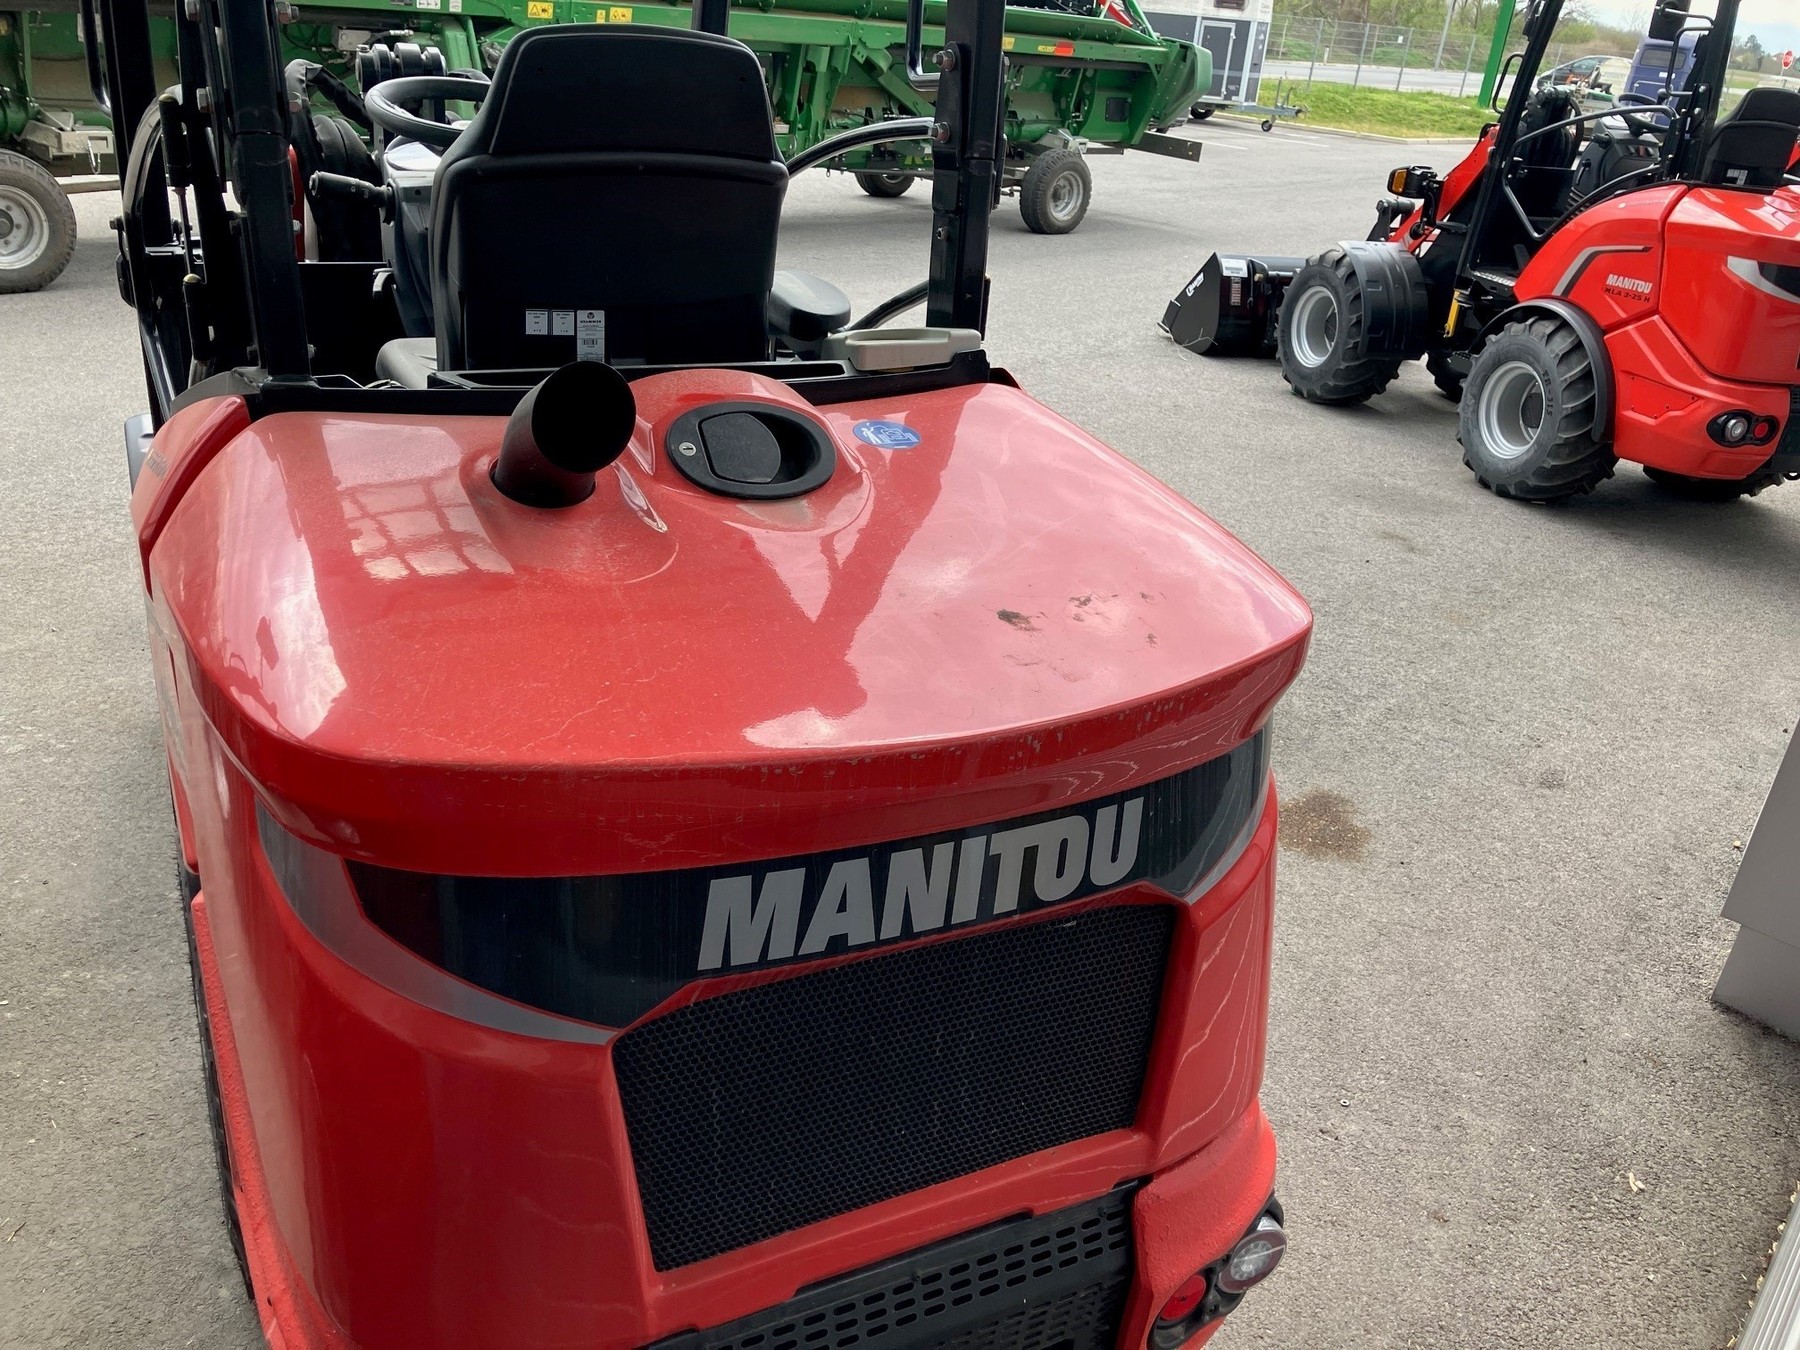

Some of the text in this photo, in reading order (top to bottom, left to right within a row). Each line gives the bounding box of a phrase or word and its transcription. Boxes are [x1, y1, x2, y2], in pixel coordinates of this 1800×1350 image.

[1604, 287, 1622, 297] MLA
[1624, 291, 1642, 301] 3-25
[1606, 273, 1653, 294] MANITOU
[697, 796, 1145, 971] MANITOU
